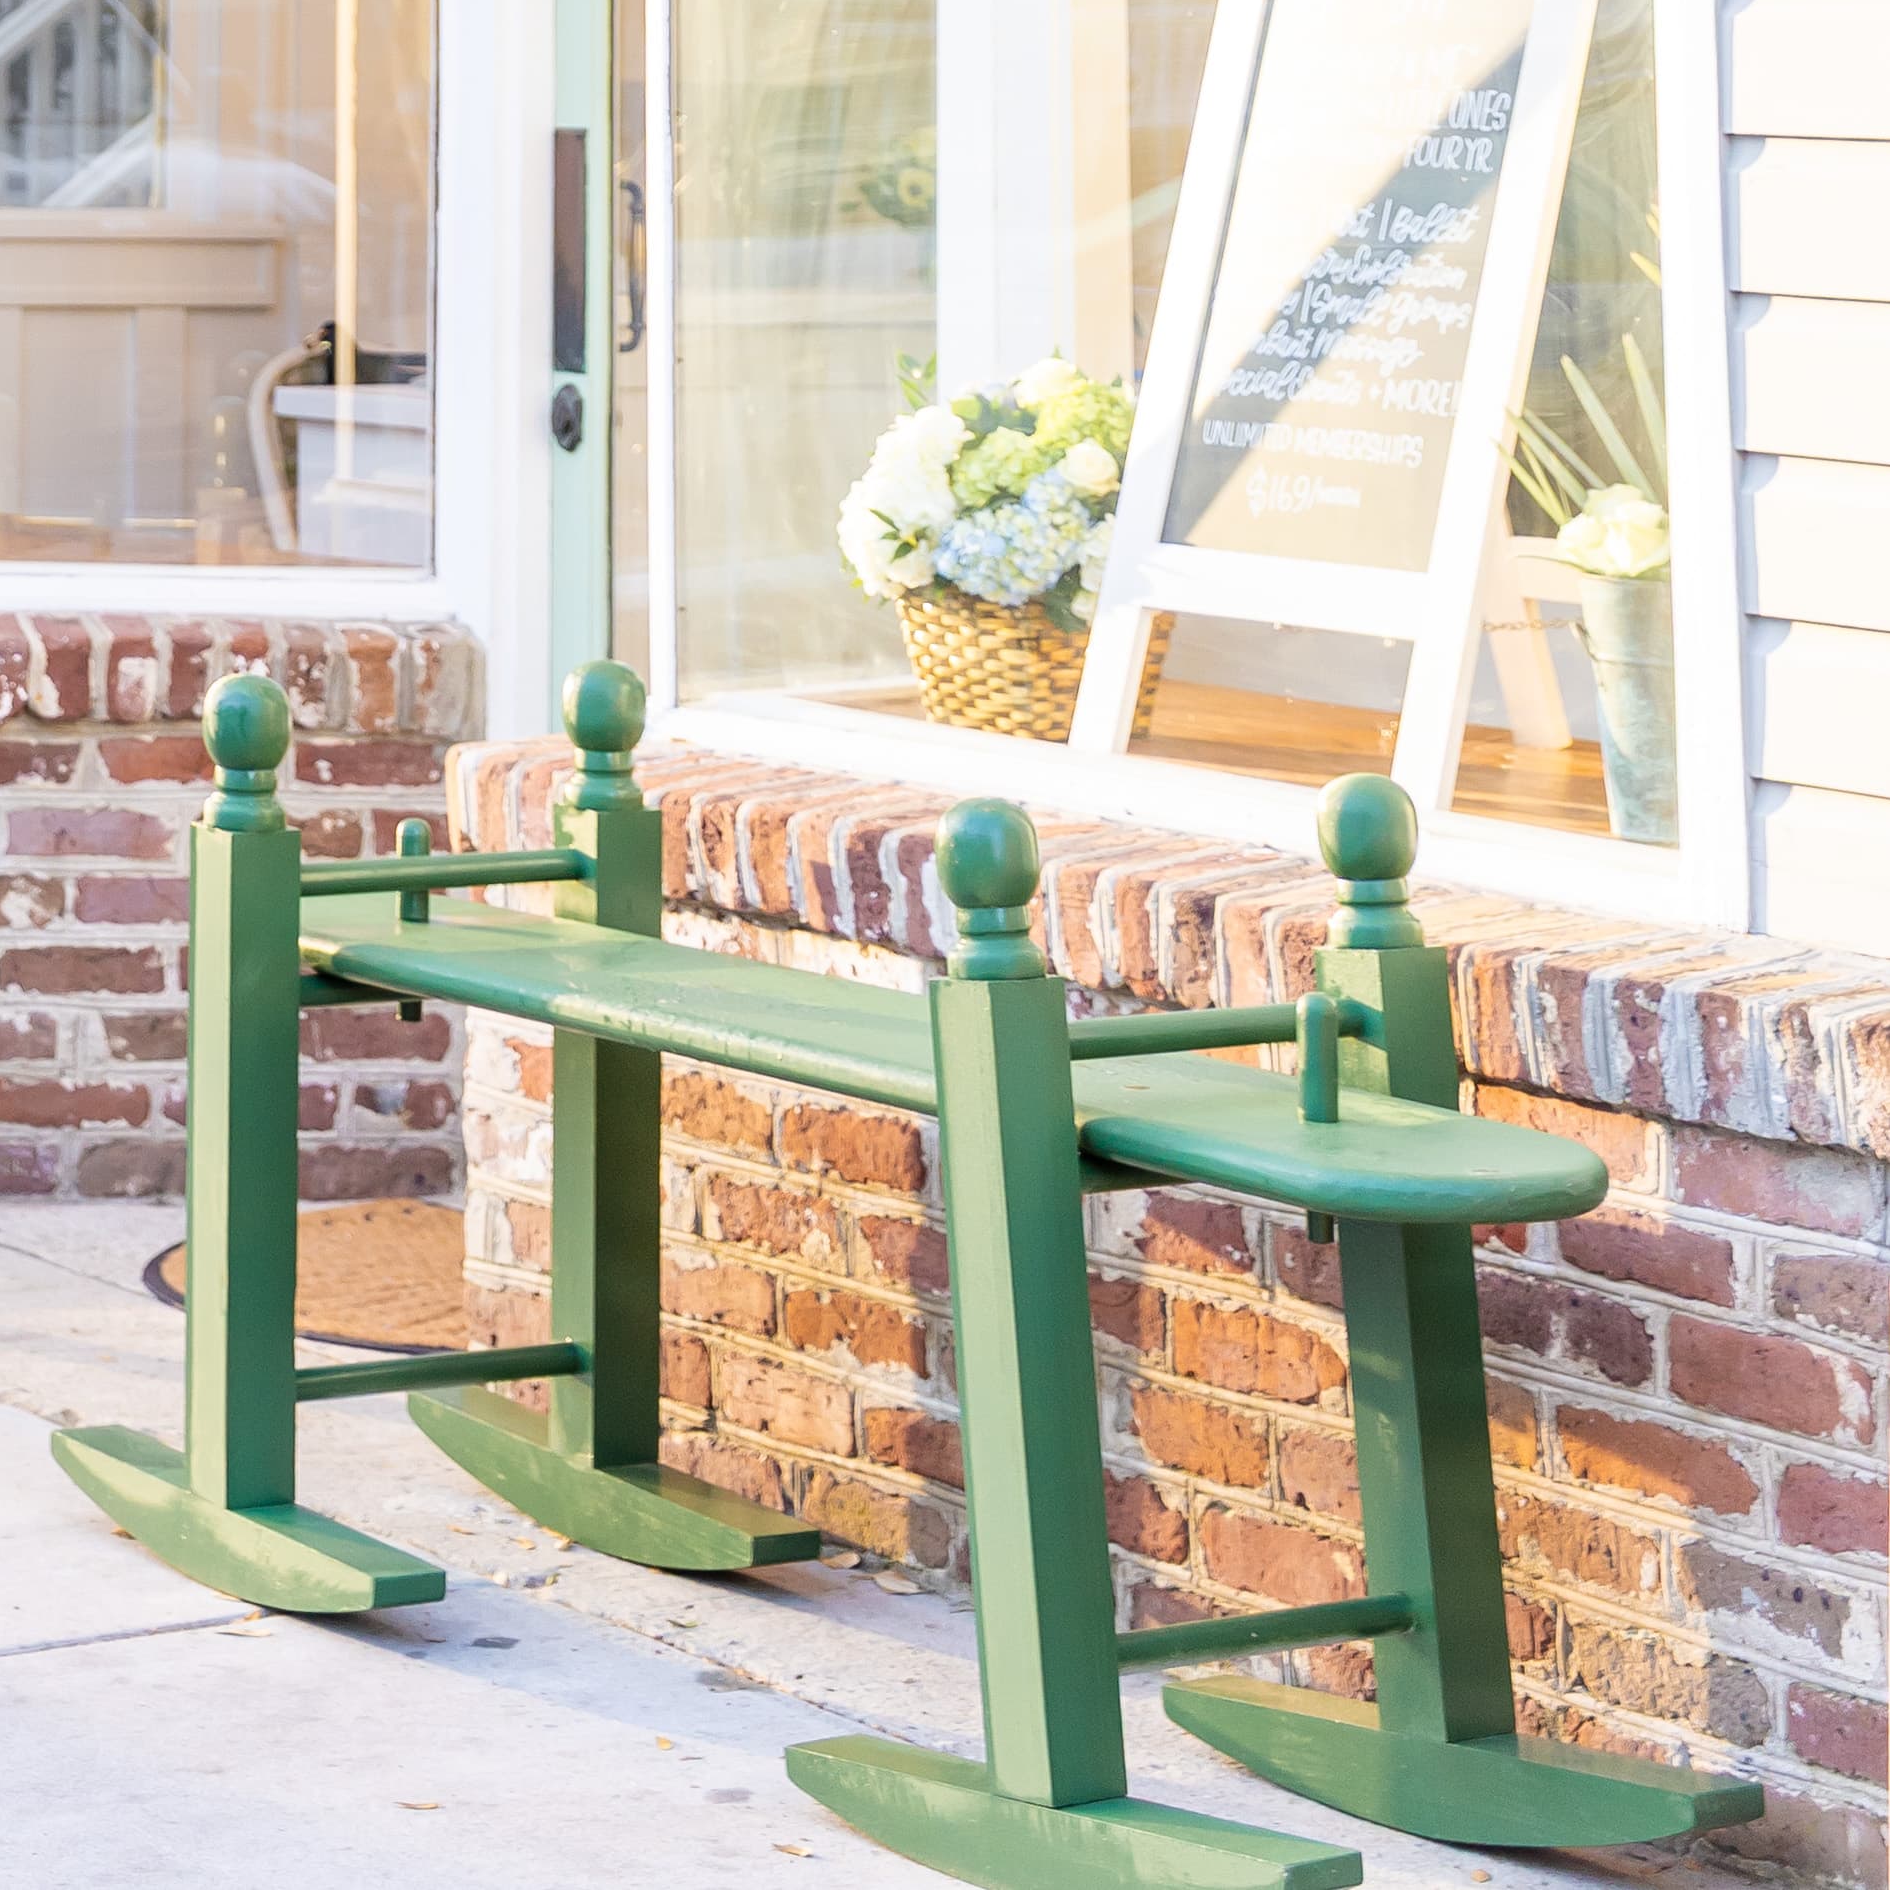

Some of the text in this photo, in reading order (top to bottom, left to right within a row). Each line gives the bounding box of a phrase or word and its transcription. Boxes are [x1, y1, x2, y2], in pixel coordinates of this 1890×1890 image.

[1448, 89, 1511, 132] ONES
[1388, 202, 1481, 243] Ballet
[1311, 282, 1392, 327] Small
[1202, 419, 1424, 468] UNLIMITED MEMBERSHIPS
